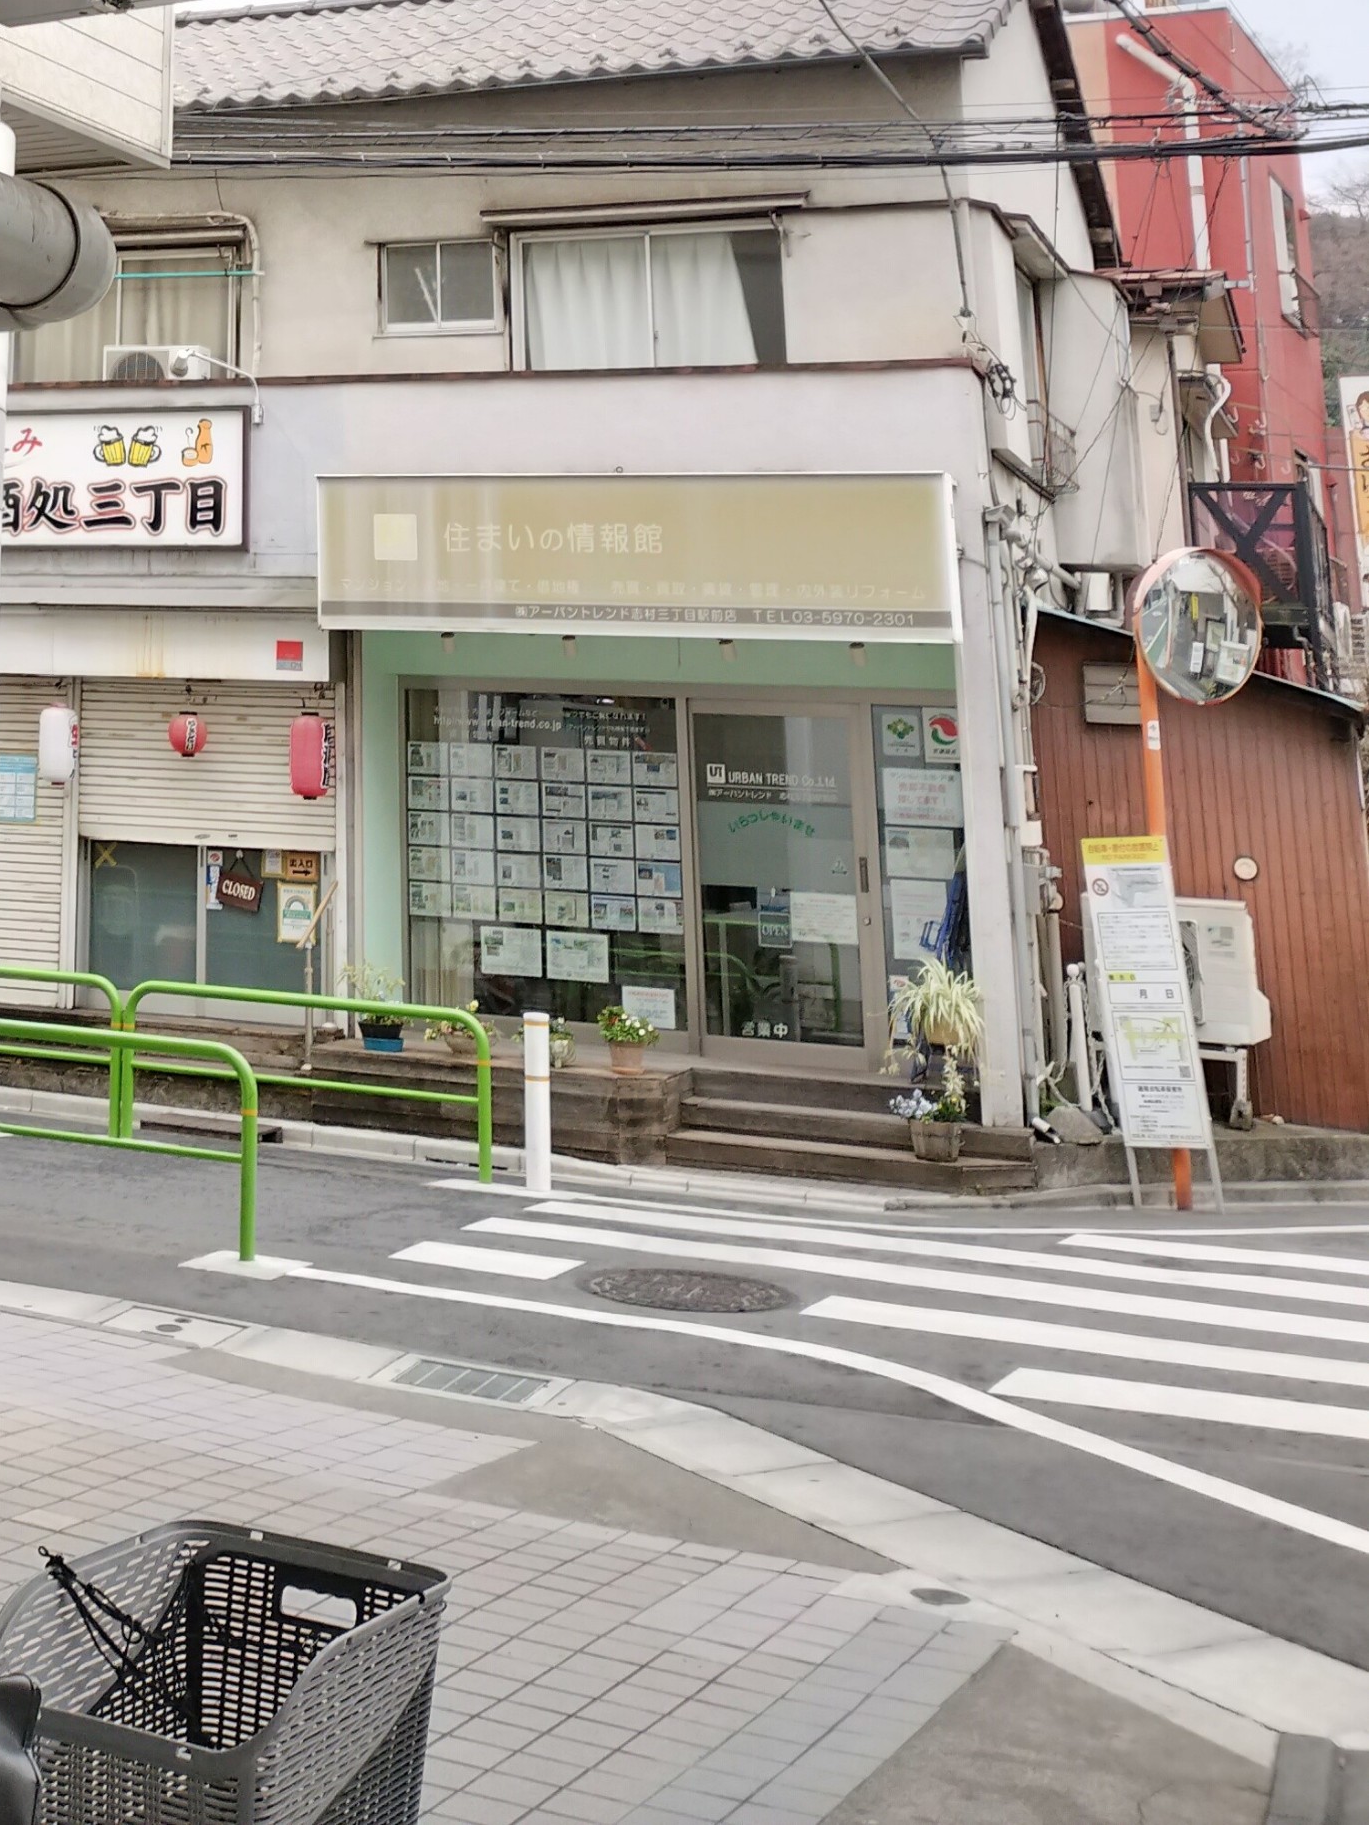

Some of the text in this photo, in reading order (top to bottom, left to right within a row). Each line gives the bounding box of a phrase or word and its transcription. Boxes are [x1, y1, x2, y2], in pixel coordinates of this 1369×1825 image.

[443, 521, 664, 555] 住まいの情報館
[728, 772, 763, 785] URBAN
[767, 773, 798, 786] TREND
[289, 858, 313, 869] 出入口
[222, 879, 256, 901] CLOSED
[761, 925, 789, 937] OPEN
[741, 1020, 789, 1039] 営業中
